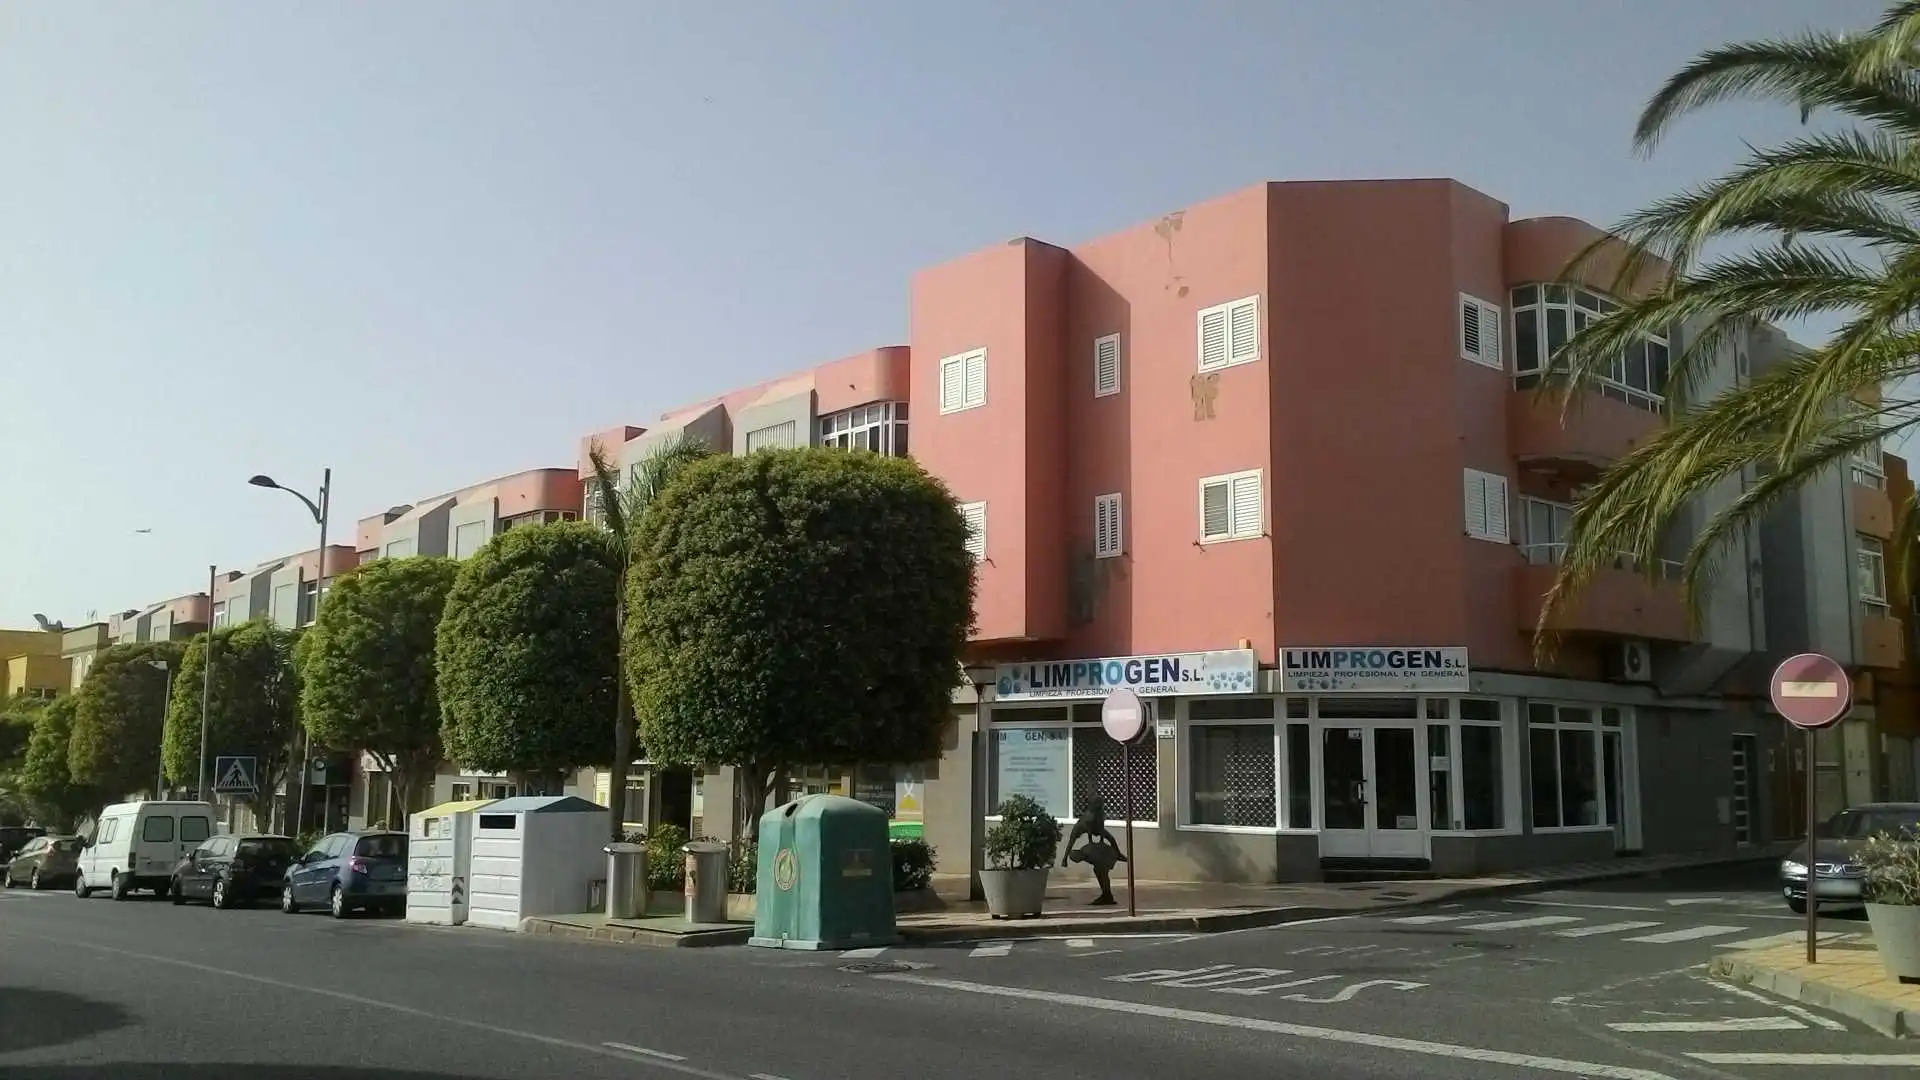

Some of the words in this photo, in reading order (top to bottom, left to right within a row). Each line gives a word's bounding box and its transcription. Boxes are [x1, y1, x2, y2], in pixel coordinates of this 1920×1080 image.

[1286, 650, 1442, 669] LIMPROGEN
[1444, 658, 1466, 669] S.L.
[1030, 658, 1180, 688] LIMPROGEN
[1182, 669, 1204, 682] S.L.
[1029, 689, 1062, 697] LIMPIEZA
[1139, 685, 1179, 693] GENERAL
[1103, 964, 1431, 1003] STOP
